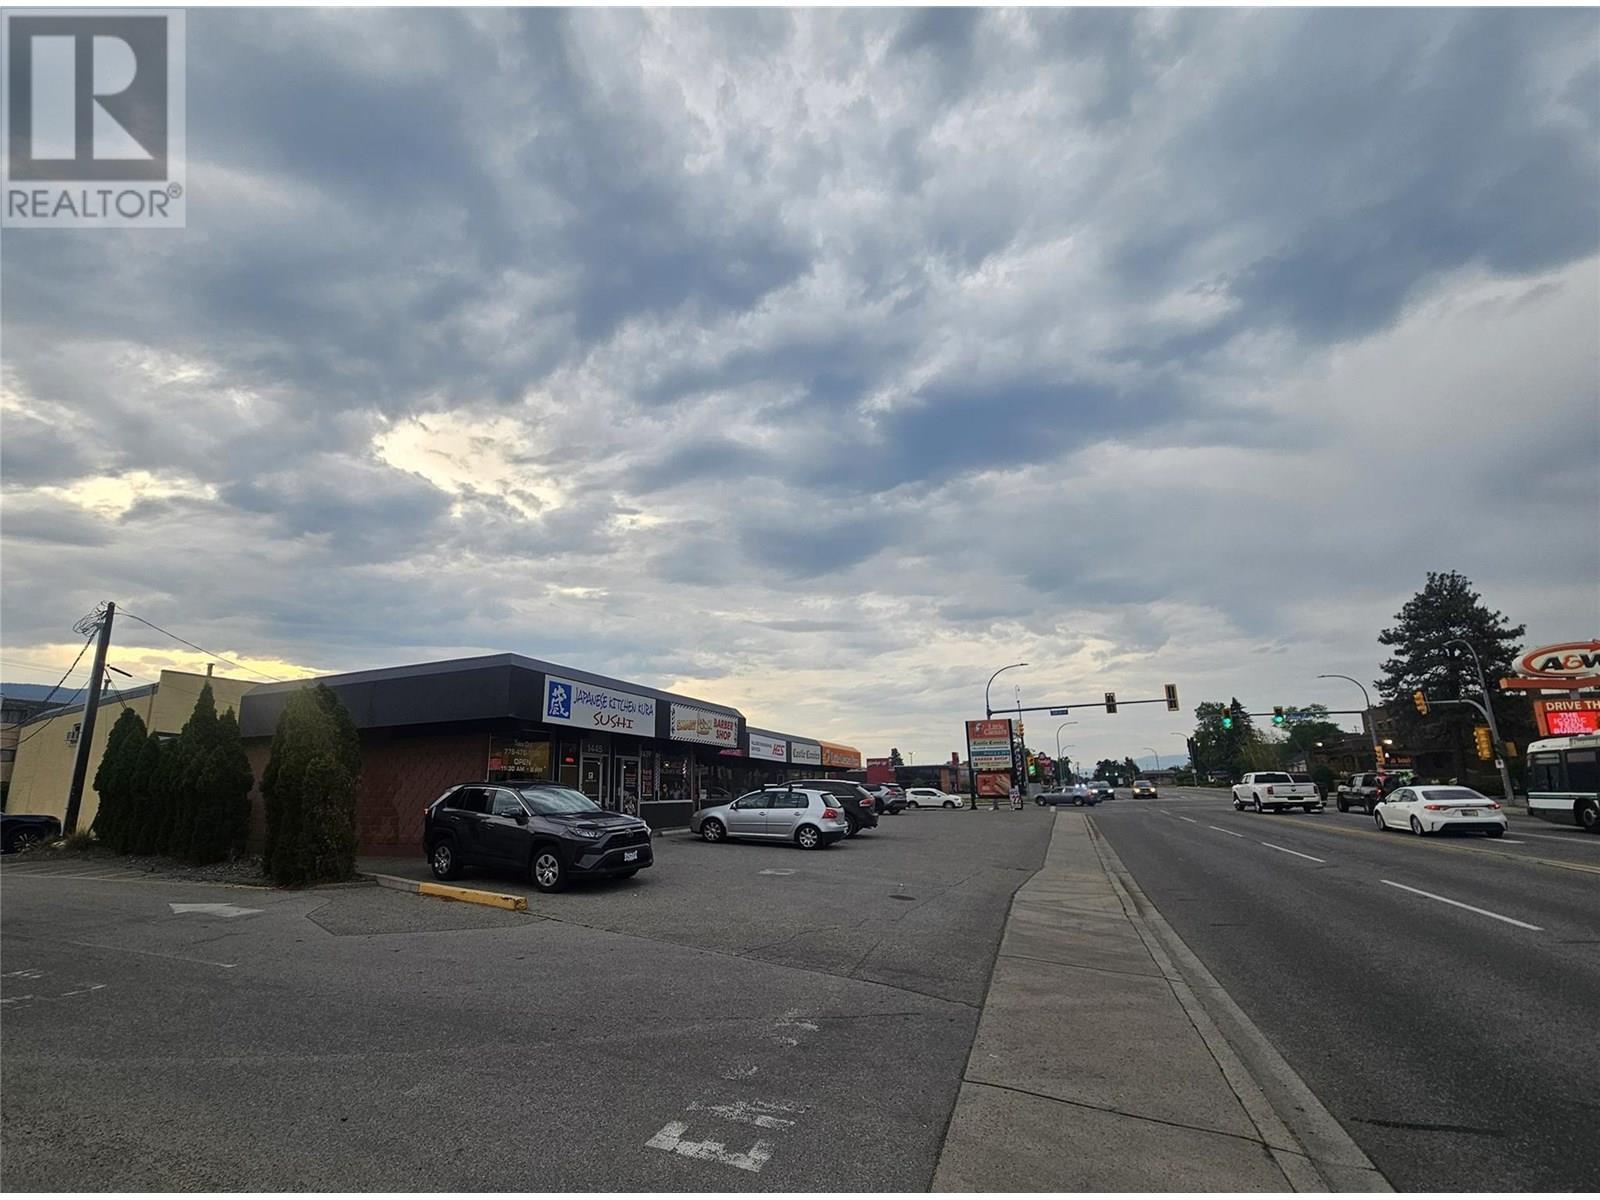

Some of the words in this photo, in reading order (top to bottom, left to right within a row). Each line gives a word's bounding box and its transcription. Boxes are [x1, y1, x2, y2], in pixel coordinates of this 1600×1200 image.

[574, 687, 608, 710] JAPANESE
[609, 696, 636, 713] KITCHEN
[638, 703, 654, 716] KURA
[1546, 701, 1582, 711] DRIVE
[593, 711, 634, 729] SUSHI
[713, 718, 734, 731] BARBER
[716, 729, 732, 740] SHOP
